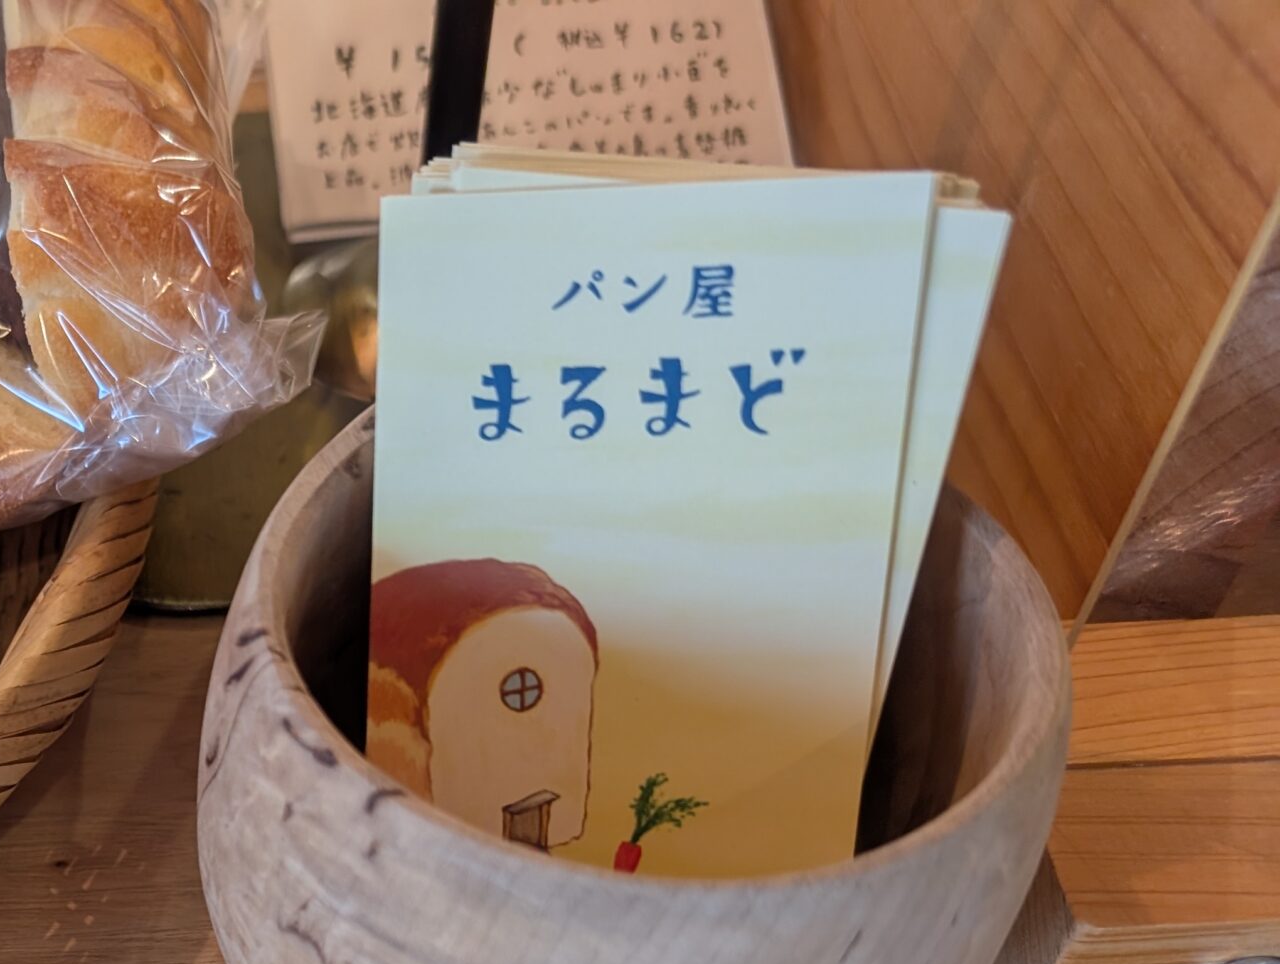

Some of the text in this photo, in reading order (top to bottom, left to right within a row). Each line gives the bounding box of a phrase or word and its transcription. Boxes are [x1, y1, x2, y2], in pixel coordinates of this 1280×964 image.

[552, 264, 735, 318] パン屋
[471, 347, 807, 441] まるまど
